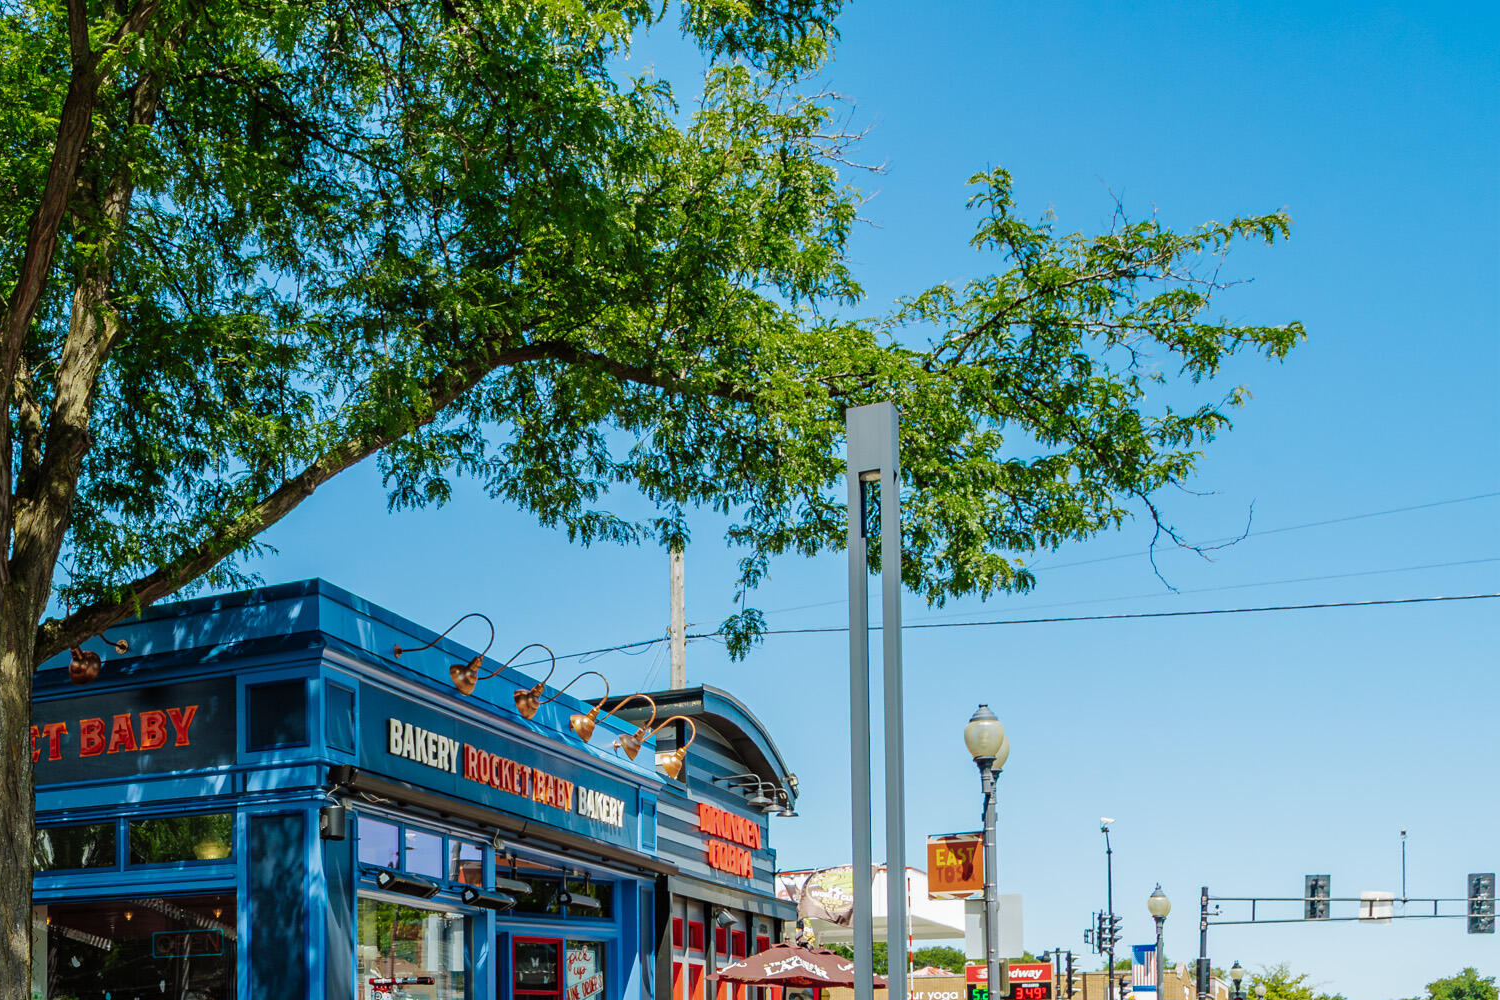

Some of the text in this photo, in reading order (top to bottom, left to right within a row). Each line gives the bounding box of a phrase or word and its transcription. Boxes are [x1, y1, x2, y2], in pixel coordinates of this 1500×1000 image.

[79, 705, 199, 758] BABY
[389, 717, 625, 828] BAKERY ROCKET BABY BAKERY
[699, 803, 761, 850] DRUNKEN
[708, 838, 754, 879] COBRA
[935, 847, 975, 866] EAST
[936, 865, 976, 884] TOSA
[566, 946, 592, 972] pick
[764, 959, 830, 980] LAGER
[573, 965, 587, 980] up
[976, 967, 1043, 979] Sdway
